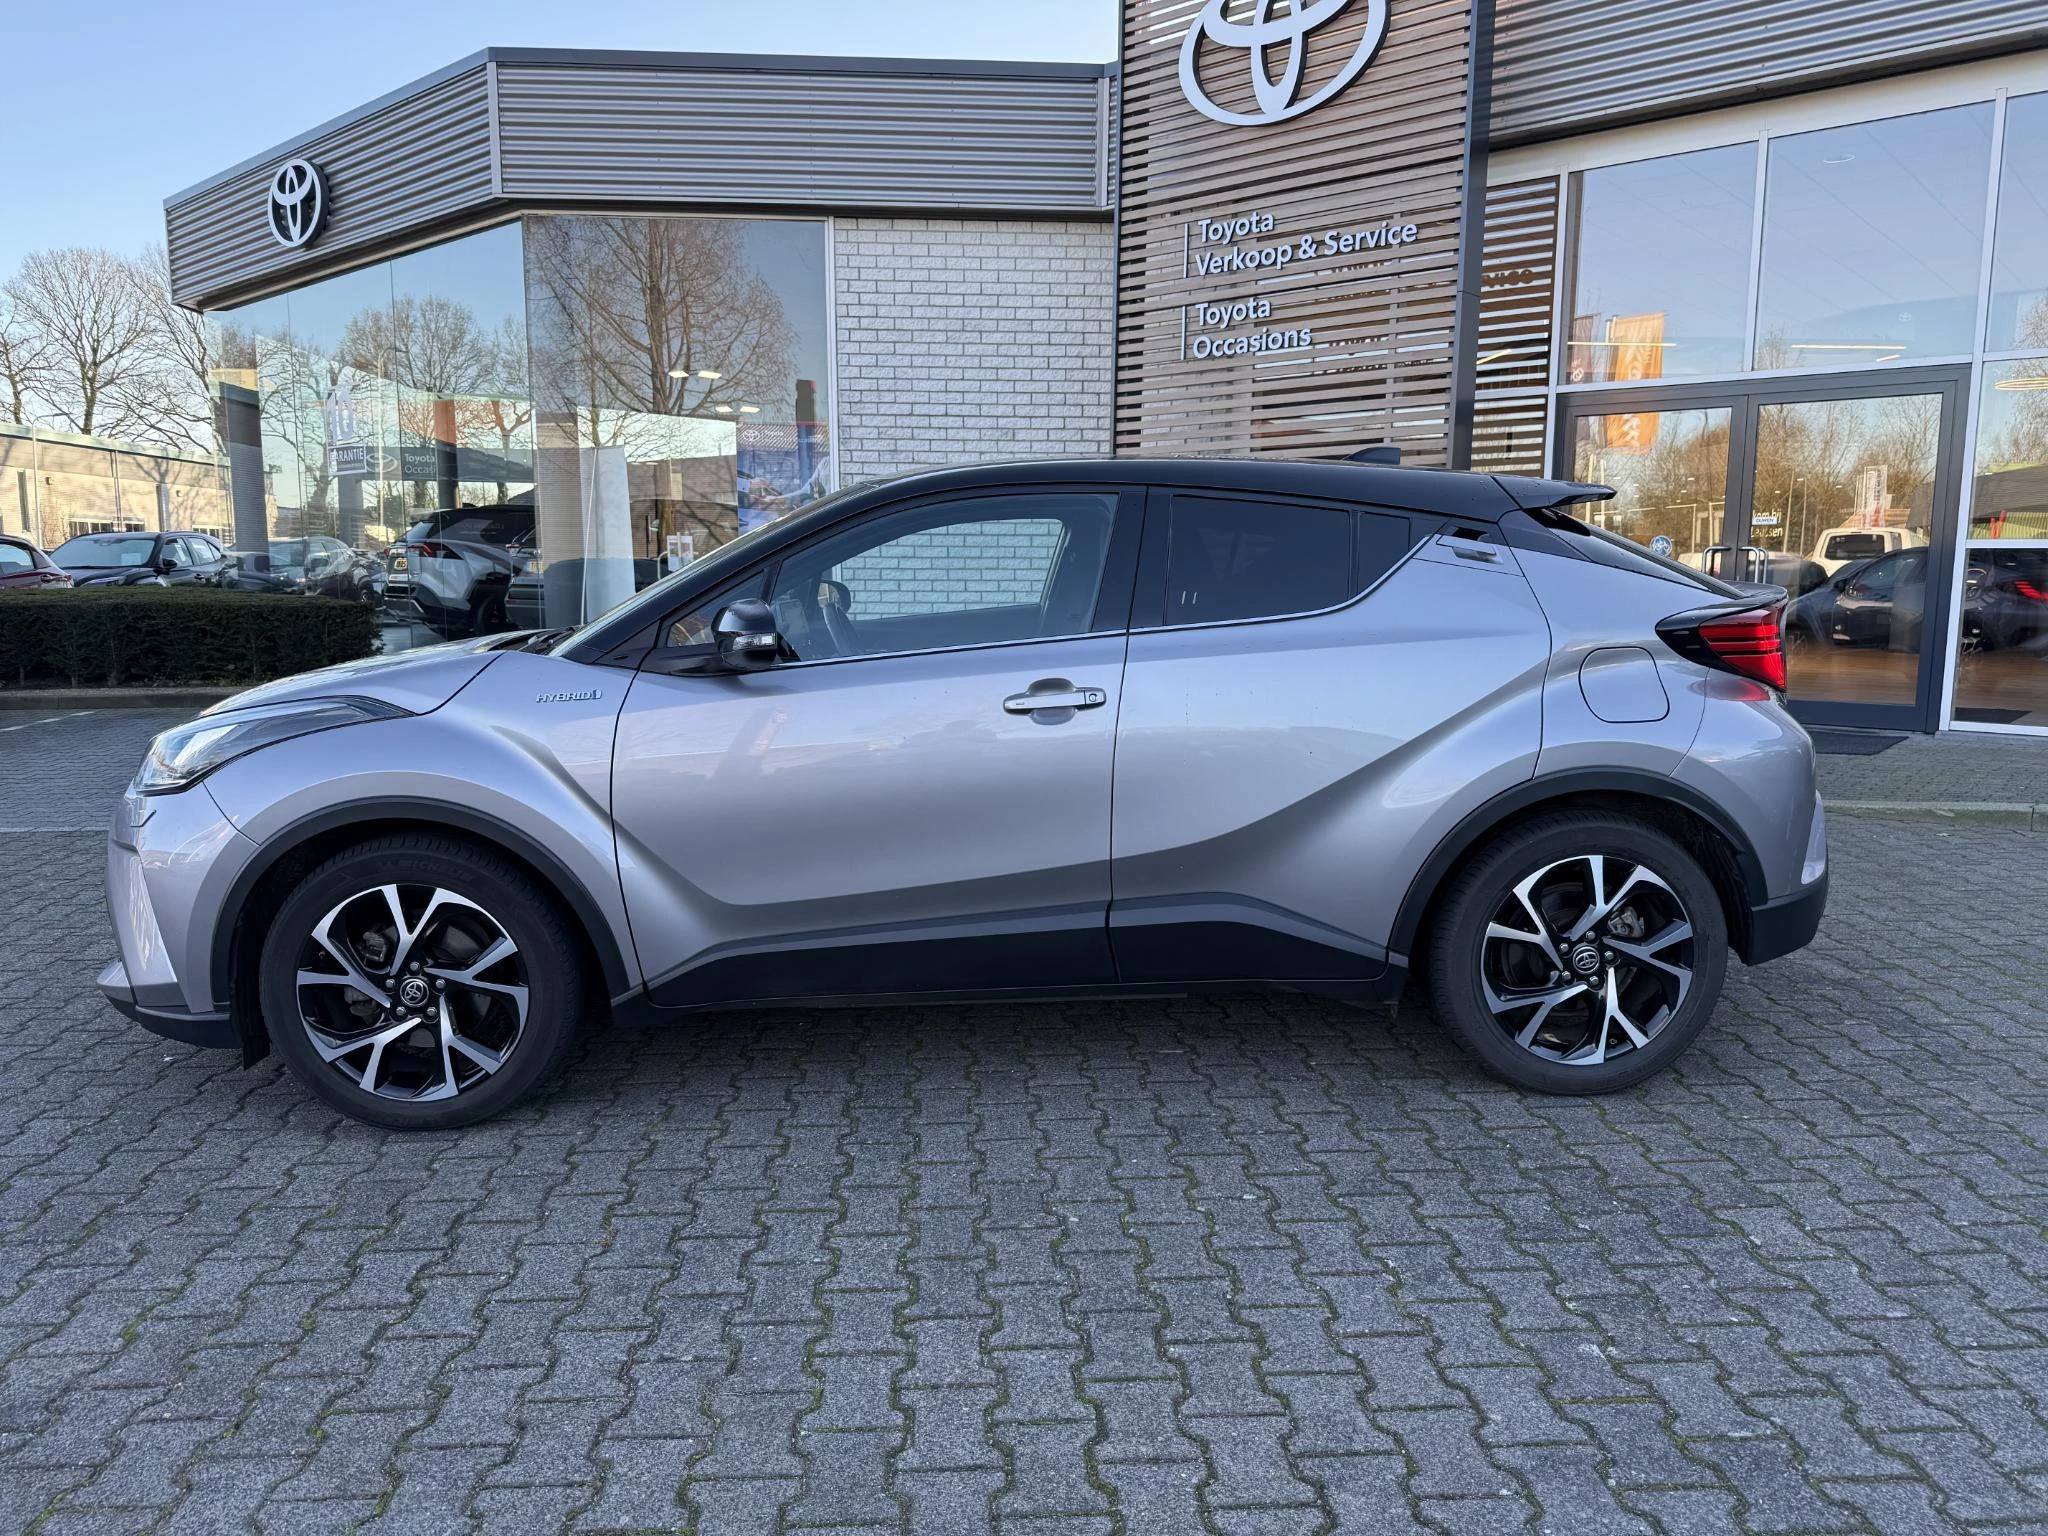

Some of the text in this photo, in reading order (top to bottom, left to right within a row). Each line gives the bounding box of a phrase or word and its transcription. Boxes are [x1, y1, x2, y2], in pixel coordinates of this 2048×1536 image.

[1198, 211, 1275, 246] Toyota
[1195, 220, 1419, 276] Verkoop & Service
[1195, 297, 1272, 329] Toyota
[1193, 326, 1312, 359] Occasions
[330, 447, 364, 462] ARANTIE
[404, 453, 435, 464] Toyota
[536, 690, 592, 703] HYBRID
